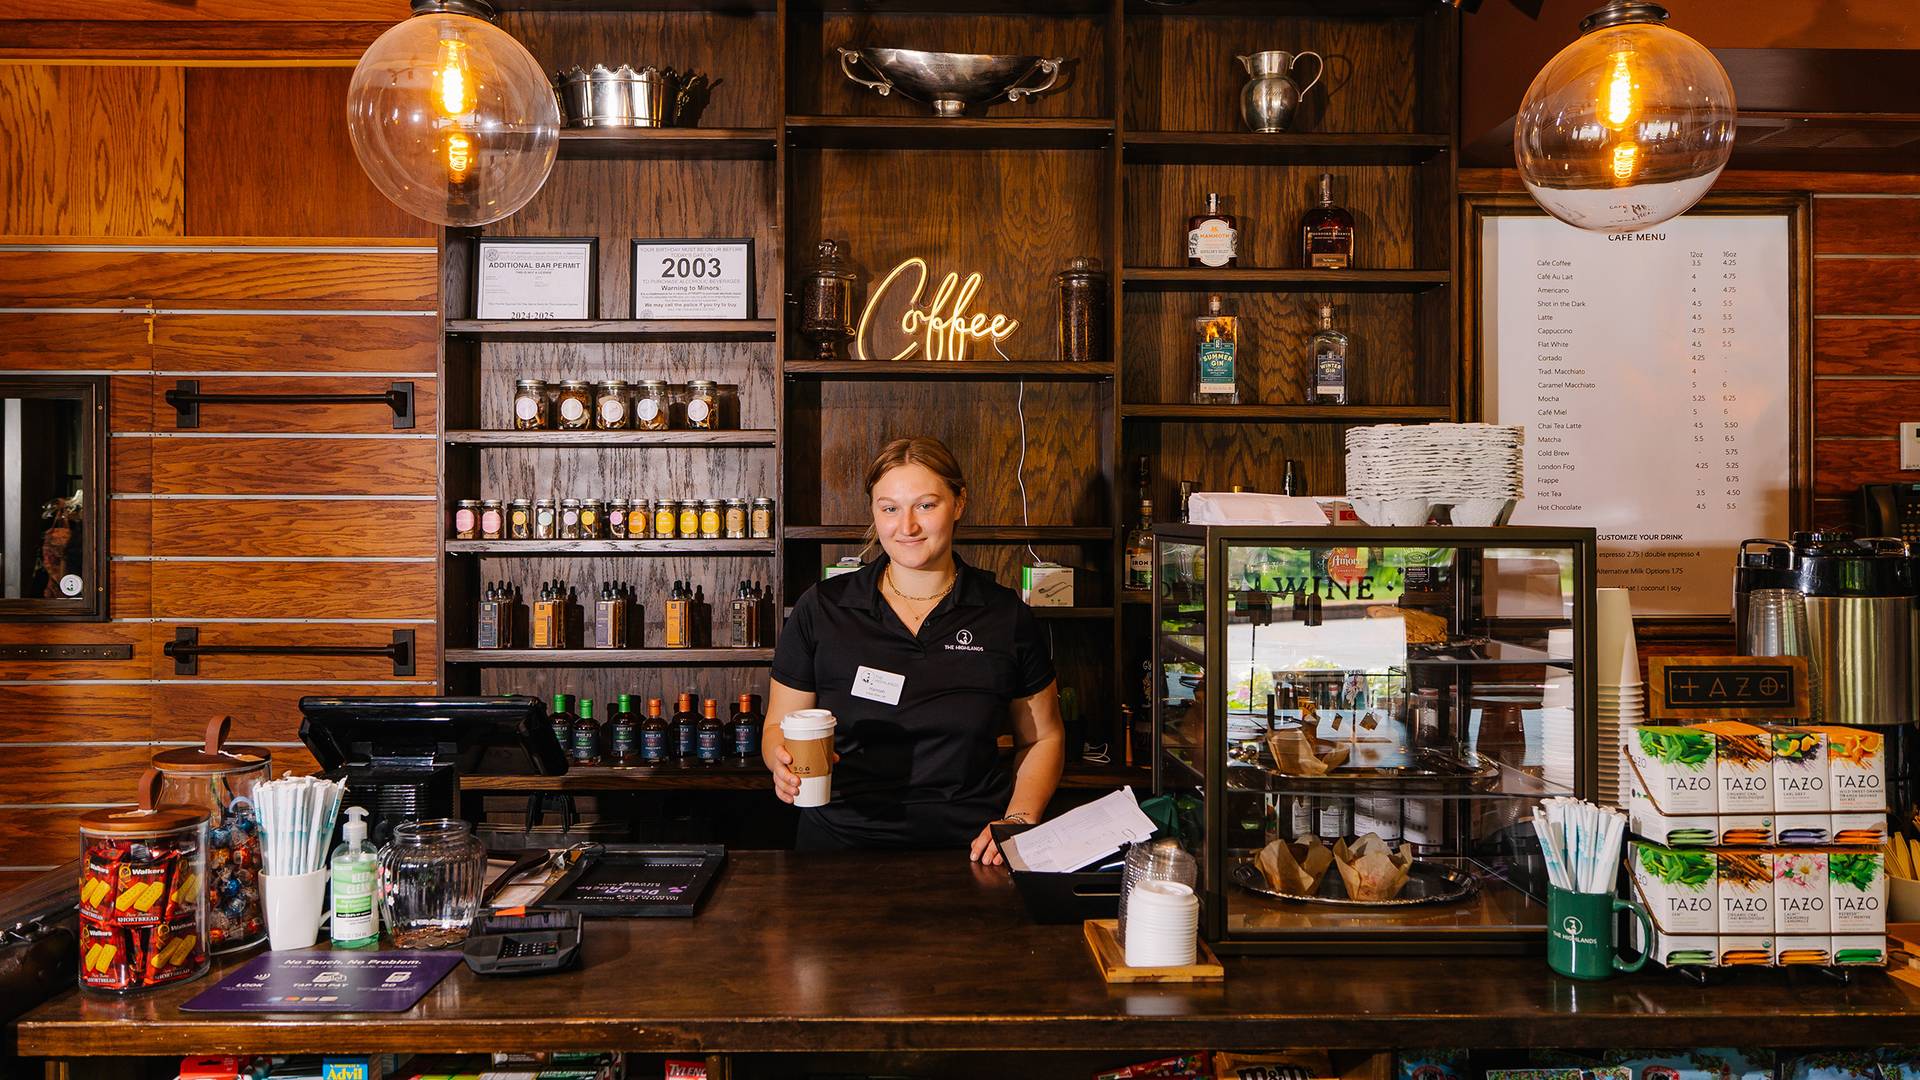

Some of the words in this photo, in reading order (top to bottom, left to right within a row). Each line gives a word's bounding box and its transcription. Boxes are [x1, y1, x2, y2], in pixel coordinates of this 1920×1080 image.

[1636, 233, 1666, 241] MENU
[661, 257, 722, 278] 2003
[1551, 259, 1571, 267] Coffee
[1552, 272, 1560, 281] Au
[1562, 272, 1573, 281] Lait
[1691, 271, 1697, 280] 4
[1537, 286, 1569, 294] Americano
[1691, 285, 1697, 294] 4
[857, 257, 1018, 361] Coffee
[1537, 300, 1551, 308] Shot
[1553, 300, 1558, 308] in
[1560, 300, 1570, 308] the
[1571, 300, 1585, 308] Dark
[1537, 313, 1553, 321] Latte
[1537, 327, 1572, 337] Cappuccino
[1538, 340, 1549, 349] Flat
[1550, 340, 1569, 349] White
[1203, 353, 1233, 362] SUMMER
[1538, 354, 1562, 362] Cortado
[1554, 367, 1585, 376] Macchiato
[1692, 366, 1697, 375] 4
[1538, 381, 1563, 389] Caramel
[1564, 381, 1596, 389] Macchiato
[1692, 380, 1697, 389] 5
[1723, 380, 1727, 389] 6
[1538, 394, 1559, 403] Mocha
[1554, 408, 1567, 416] Miel
[1693, 407, 1697, 416] 5
[1724, 407, 1728, 416] 6
[1538, 422, 1552, 430] Chai
[1553, 422, 1564, 430] Tea
[1566, 422, 1582, 430] Latte
[1538, 436, 1561, 444] Matcha
[1538, 449, 1552, 457] Cold
[1553, 449, 1569, 457] Brew
[1538, 463, 1561, 471] London
[1562, 463, 1575, 473] Fog
[1538, 476, 1559, 487] Frappe
[1538, 490, 1549, 498] Hot
[1550, 490, 1562, 498] Tea
[1537, 503, 1549, 512] Hot
[1550, 503, 1582, 512] Chocolate
[1597, 533, 1638, 541] CUSTOMIZE
[1639, 533, 1659, 541] YOUR
[1660, 533, 1683, 541] DRINK
[1599, 552, 1627, 560] espresso
[1644, 550, 1666, 558] double
[1667, 552, 1695, 560] espresso
[1630, 567, 1644, 575] Milk
[1645, 567, 1670, 577] Options
[1272, 575, 1374, 600] WINE
[1667, 776, 1711, 791] TAZO
[1723, 776, 1767, 791] TAZO
[1779, 776, 1823, 791] TAZO
[1835, 774, 1880, 789] TAZO
[1668, 897, 1712, 911] TAZO
[1724, 897, 1767, 911] TAZO
[1780, 897, 1824, 911] TAZO
[1835, 896, 1879, 911] TAZO
[89, 929, 112, 937] Walkers
[1552, 930, 1561, 939] THE
[1563, 934, 1597, 944] HIGHLANDS
[367, 958, 422, 966] Problem.
[327, 1066, 362, 1080] Advil
